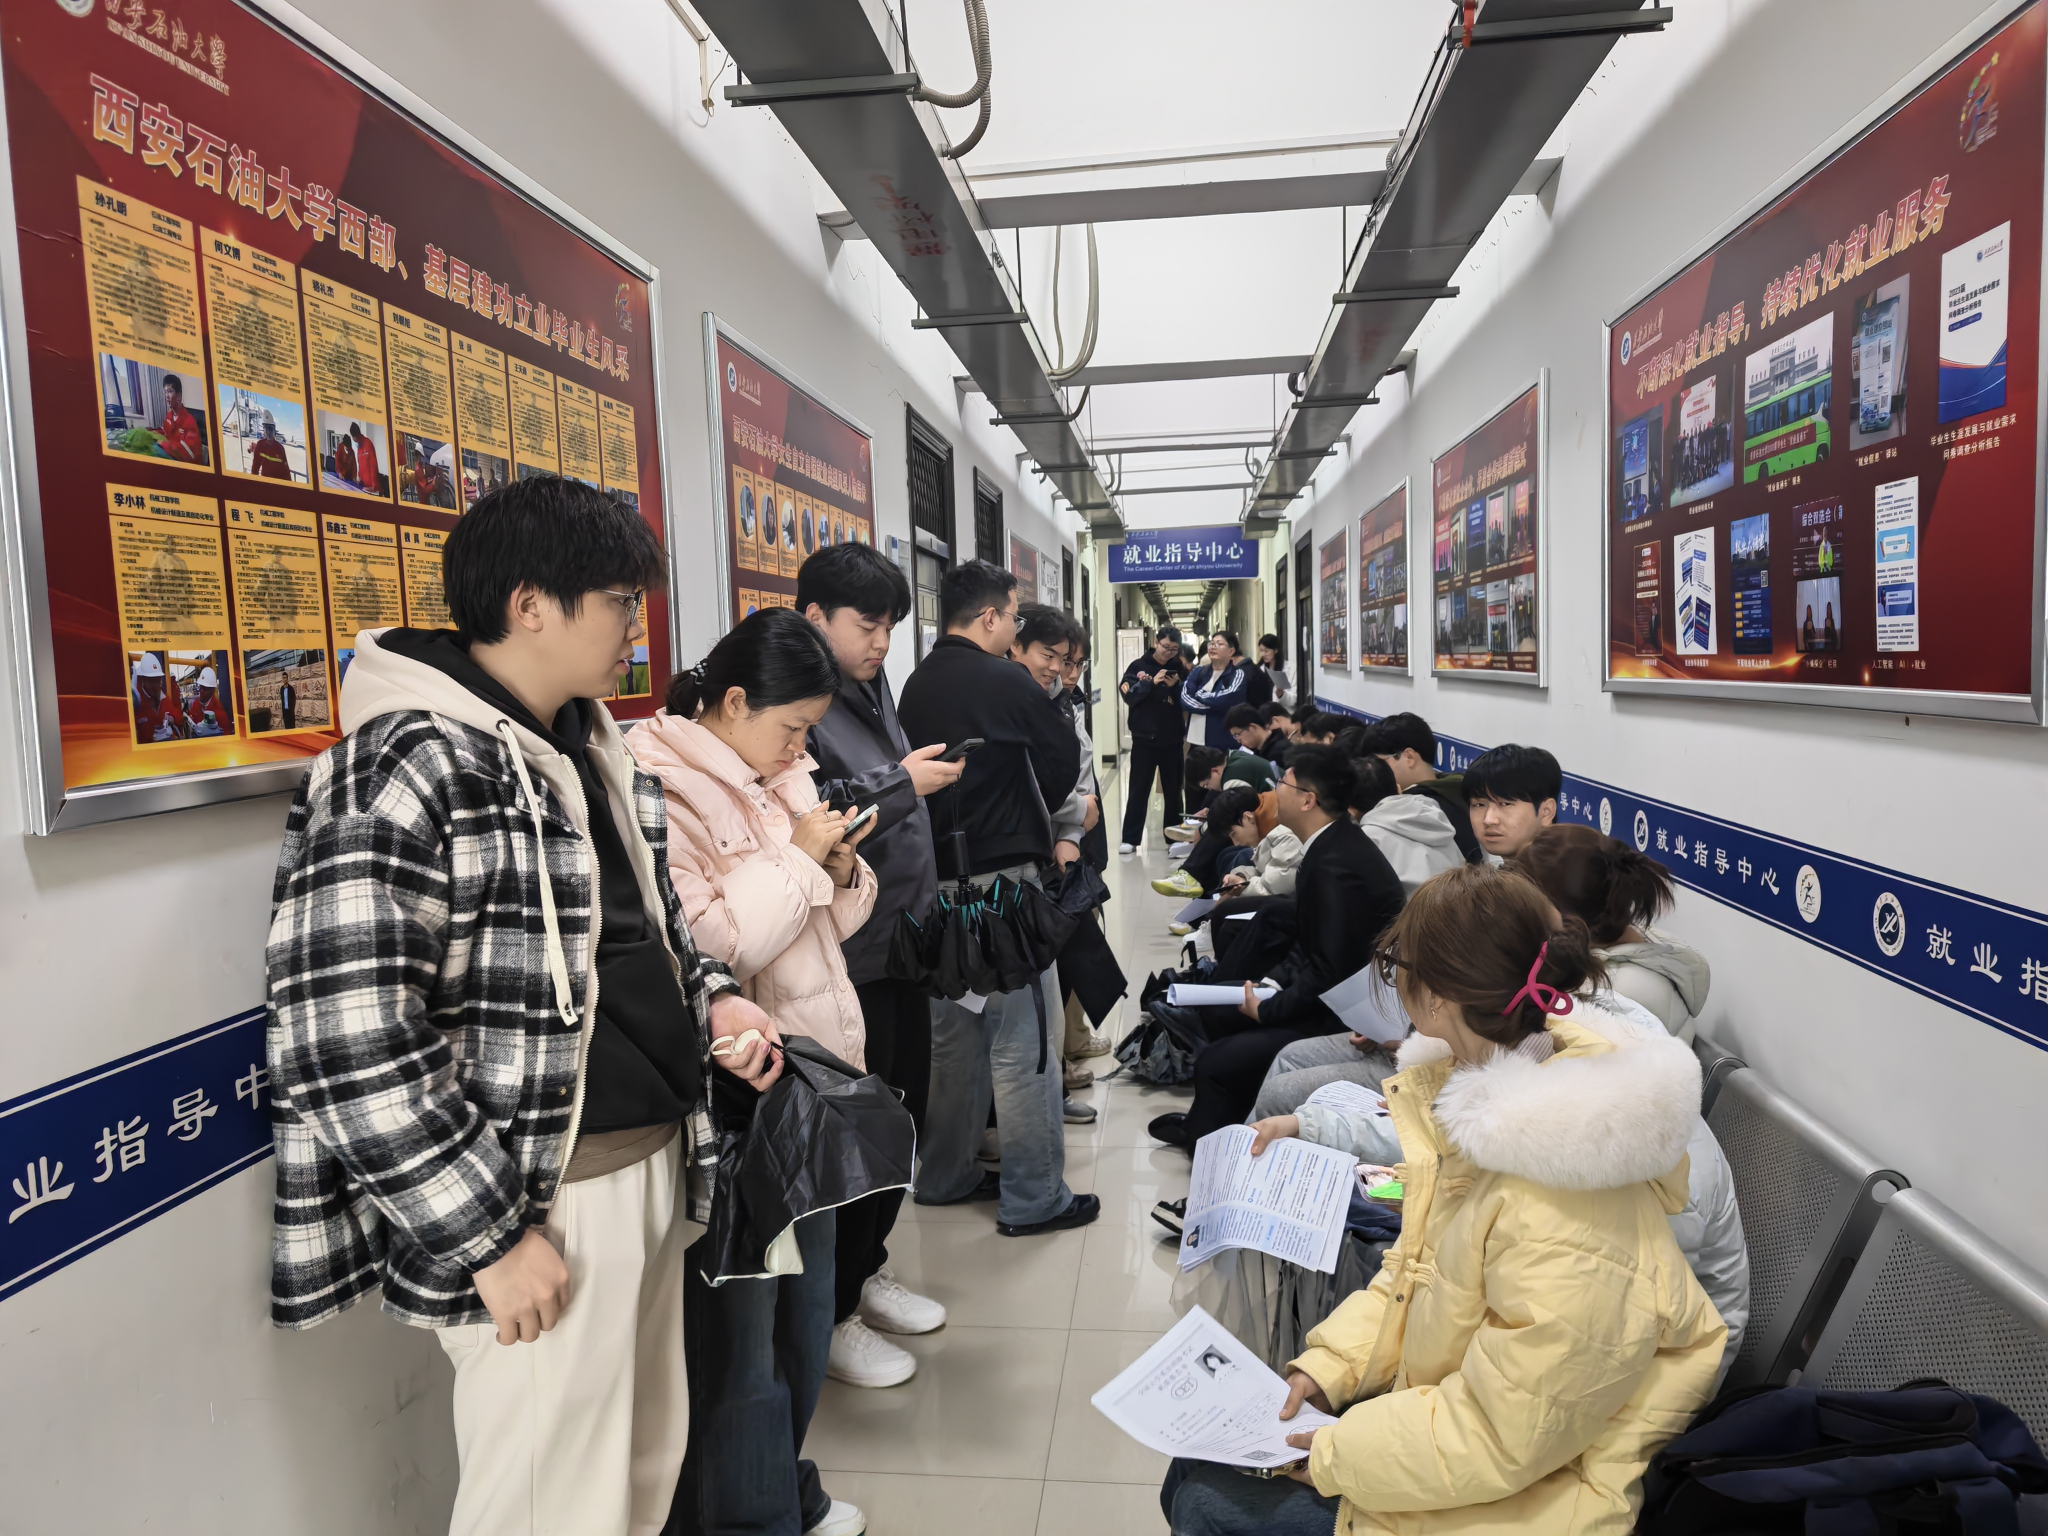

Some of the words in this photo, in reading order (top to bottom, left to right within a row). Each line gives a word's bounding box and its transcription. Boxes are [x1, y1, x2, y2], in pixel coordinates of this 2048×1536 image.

[94, 191, 127, 217] 孙孔明
[90, 72, 629, 381] 西安石油大学西部、基层建功立业毕业生风采
[1930, 413, 2017, 447] 毕业生生涯发展与就业需求
[1943, 437, 2001, 461] 问卷调查分析报告
[114, 492, 146, 510] 李小林
[245, 510, 254, 523] 飞
[1123, 542, 1244, 564] 就业指导中心
[1560, 792, 1593, 821] 导中心
[1656, 827, 1780, 896] 就业指导中心
[1926, 923, 2048, 1005] 就业指
[9, 1063, 271, 1224] 业指导中
